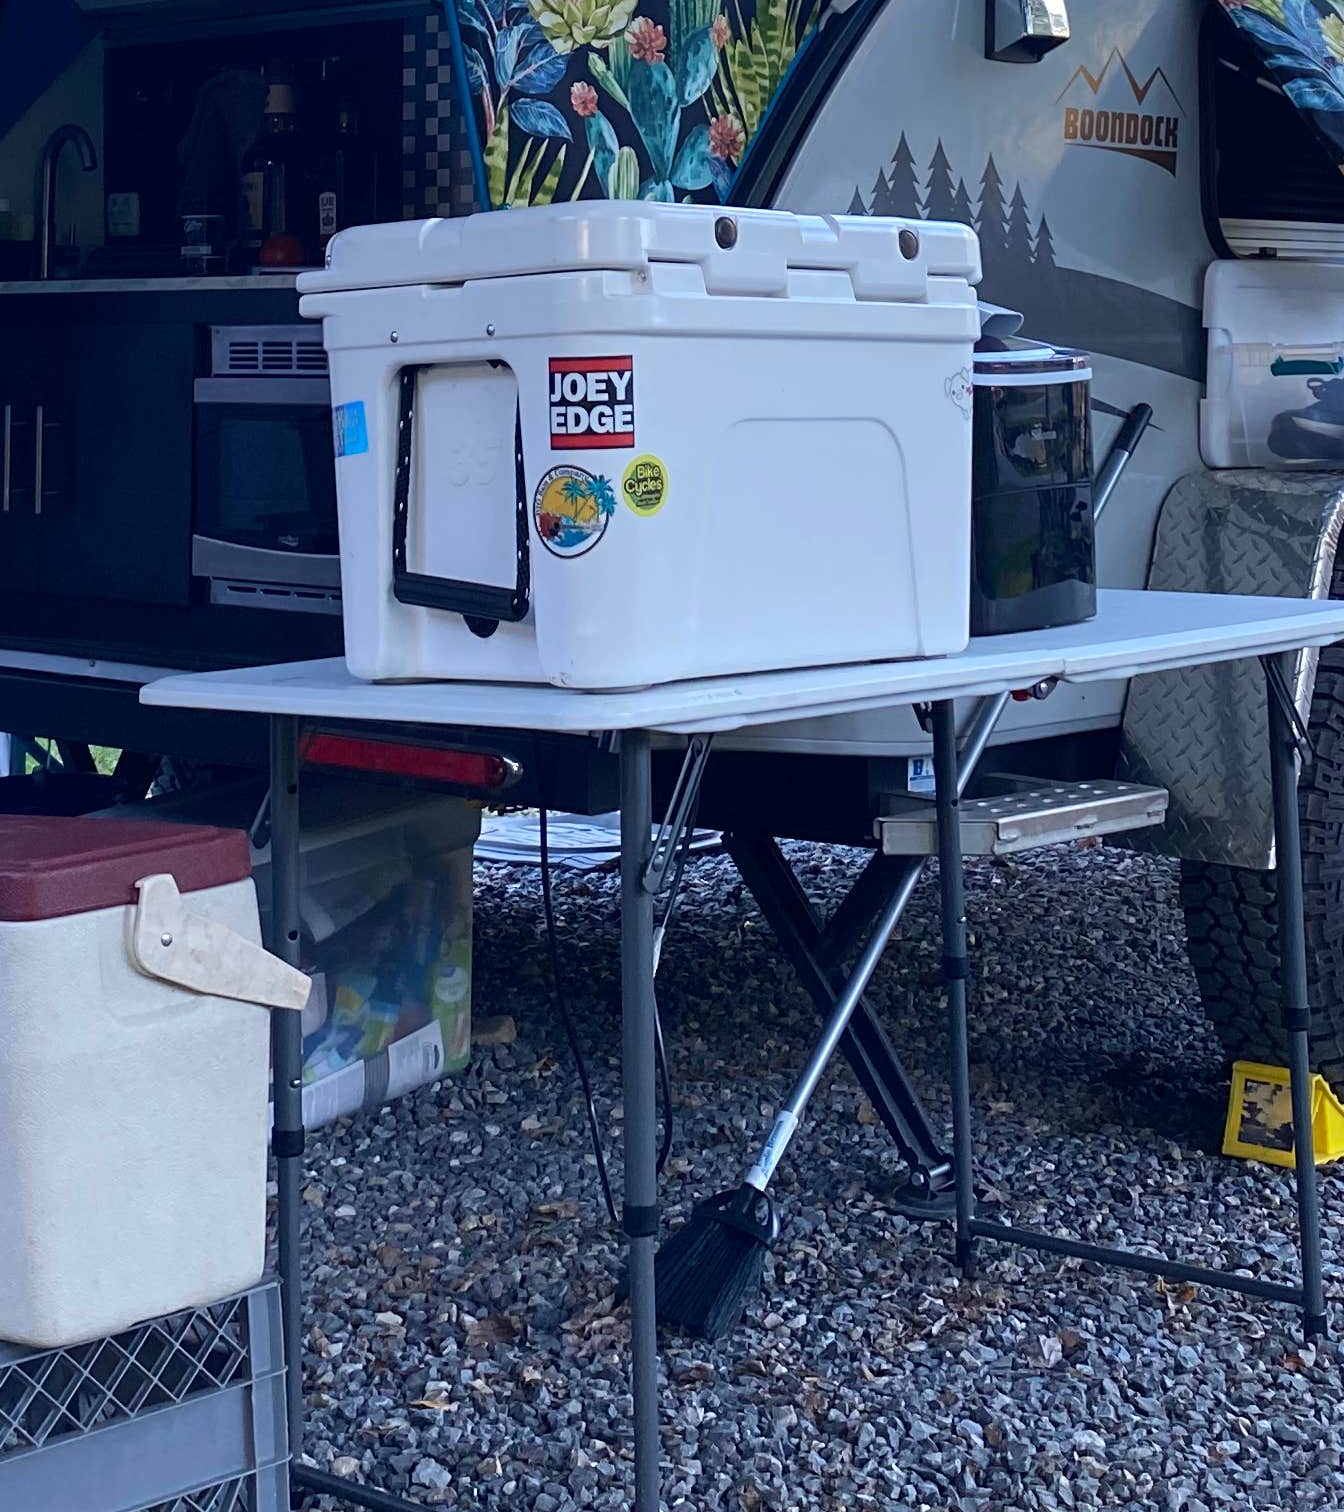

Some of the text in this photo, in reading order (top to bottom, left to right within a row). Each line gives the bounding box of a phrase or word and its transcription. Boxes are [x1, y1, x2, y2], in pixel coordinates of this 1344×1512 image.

[1064, 107, 1179, 148] BOONDOCK
[551, 371, 632, 402] JOEY
[551, 405, 634, 434] EDGE
[637, 465, 660, 478] Bike
[625, 478, 663, 496] Cycles
